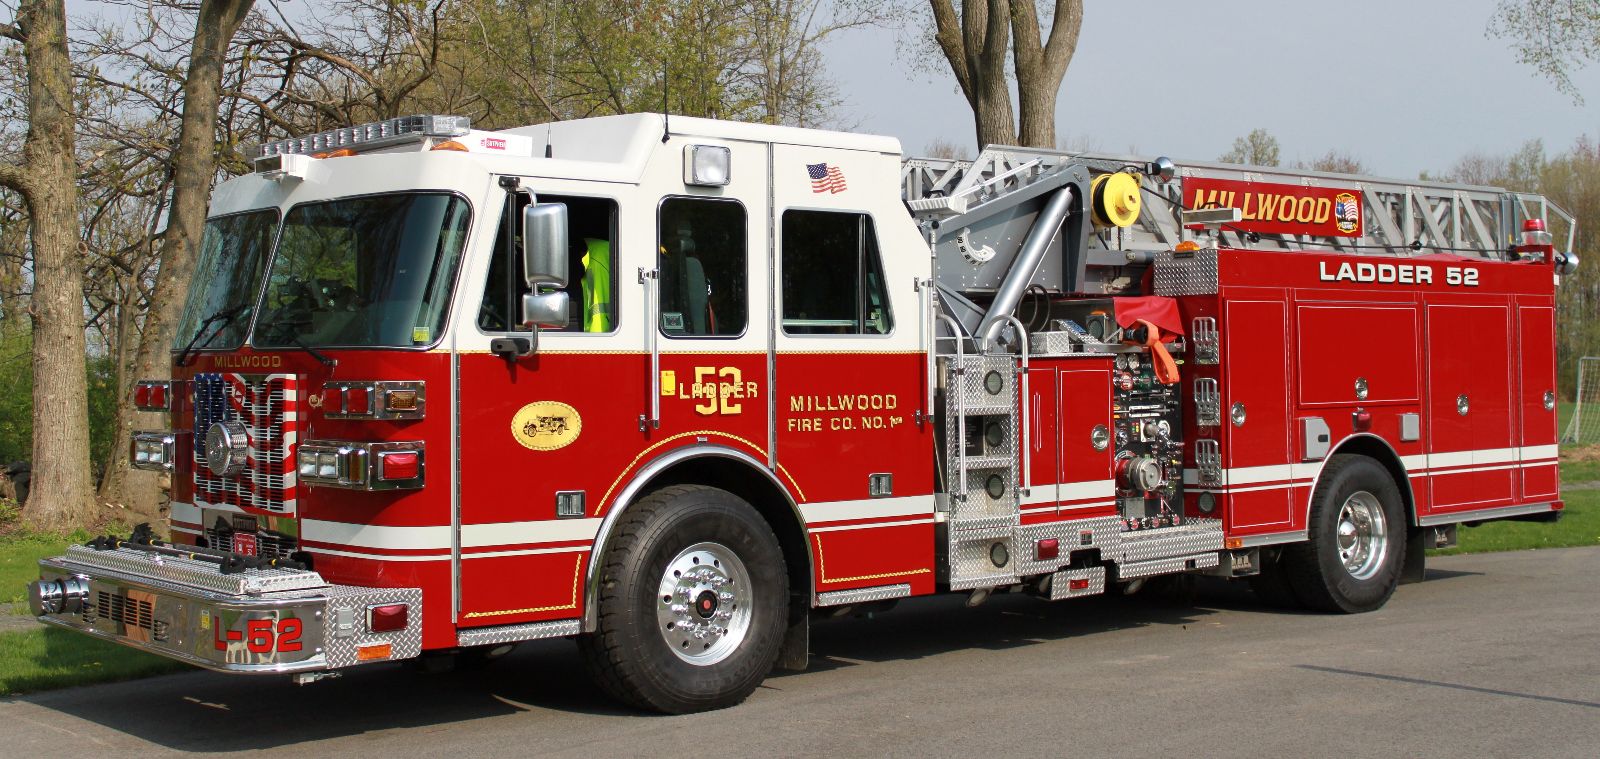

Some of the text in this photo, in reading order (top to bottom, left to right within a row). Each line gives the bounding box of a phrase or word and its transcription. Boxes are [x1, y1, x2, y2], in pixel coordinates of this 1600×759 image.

[1319, 261, 1479, 286] LADDER 52
[214, 355, 281, 368] MILLWOOD
[679, 381, 758, 399] LADDER
[694, 366, 742, 415] 52
[790, 394, 897, 412] MILLWOOD
[787, 418, 823, 432] FIRE
[830, 417, 857, 431] CO.
[861, 415, 887, 430] NO.
[214, 615, 303, 654] L-52
